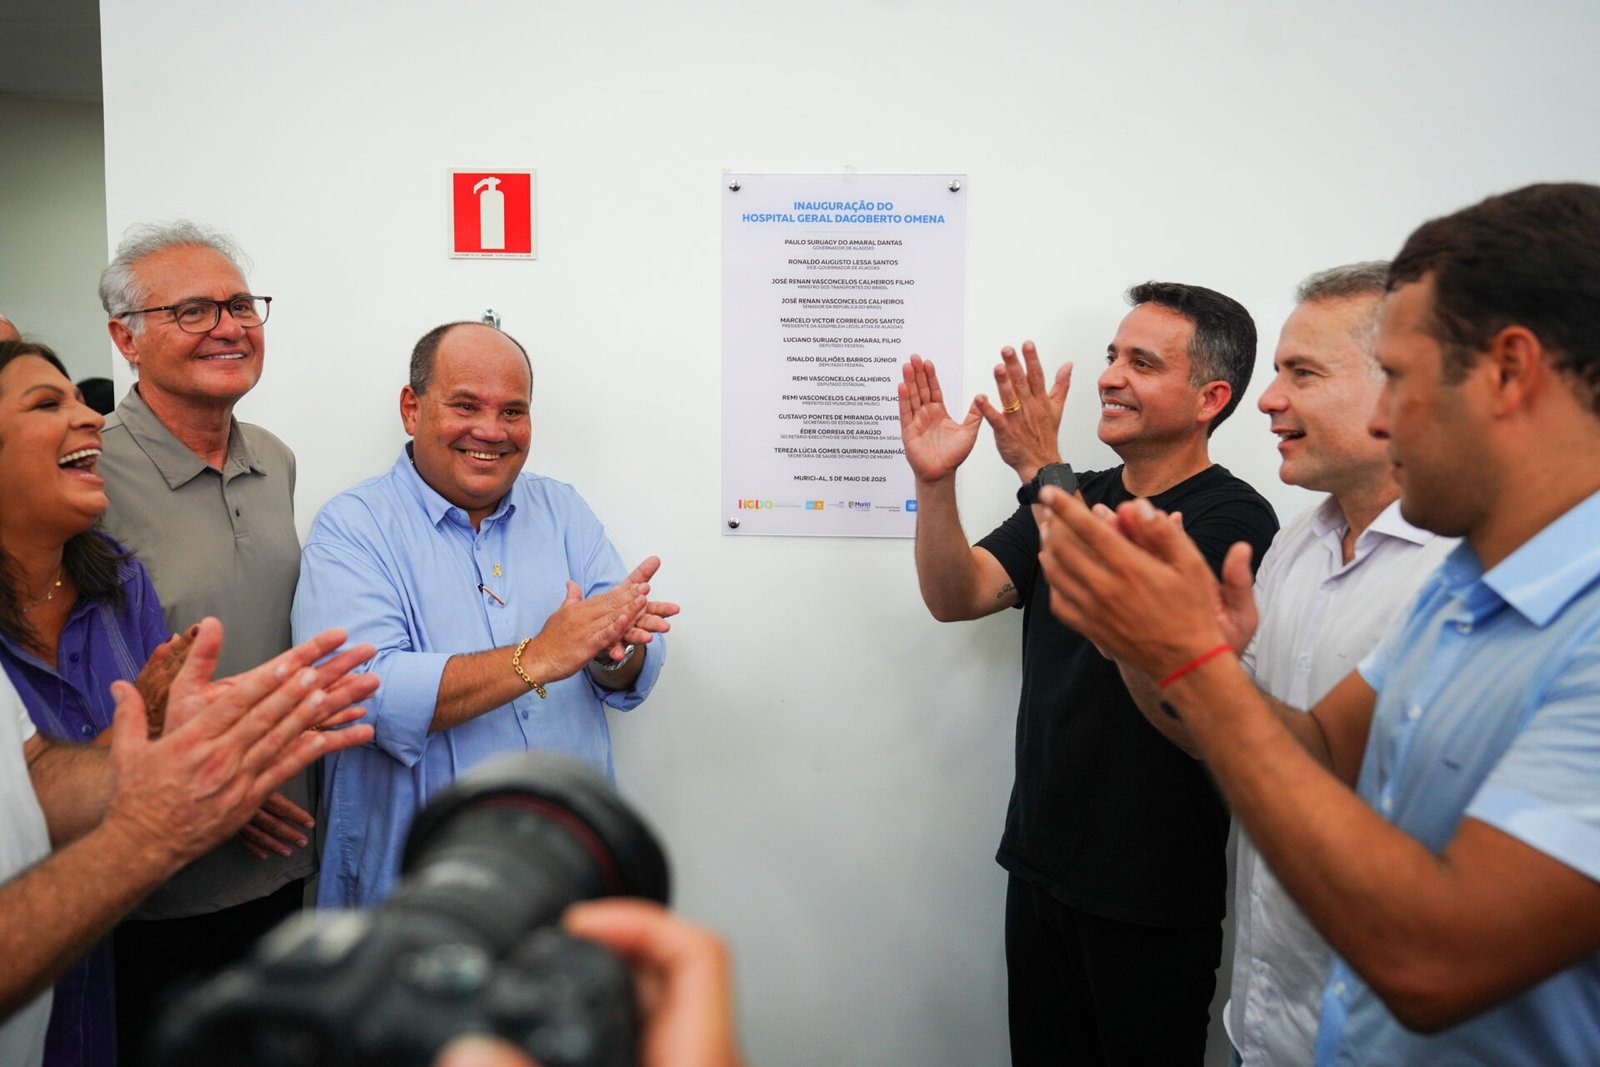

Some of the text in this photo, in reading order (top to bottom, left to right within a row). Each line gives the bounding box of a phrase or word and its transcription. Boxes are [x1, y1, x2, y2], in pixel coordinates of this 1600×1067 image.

[794, 200, 893, 212] INAUGURAÇÃO DO
[743, 214, 945, 223] HOSPITAL GERAL DAGOBERTO OMENA
